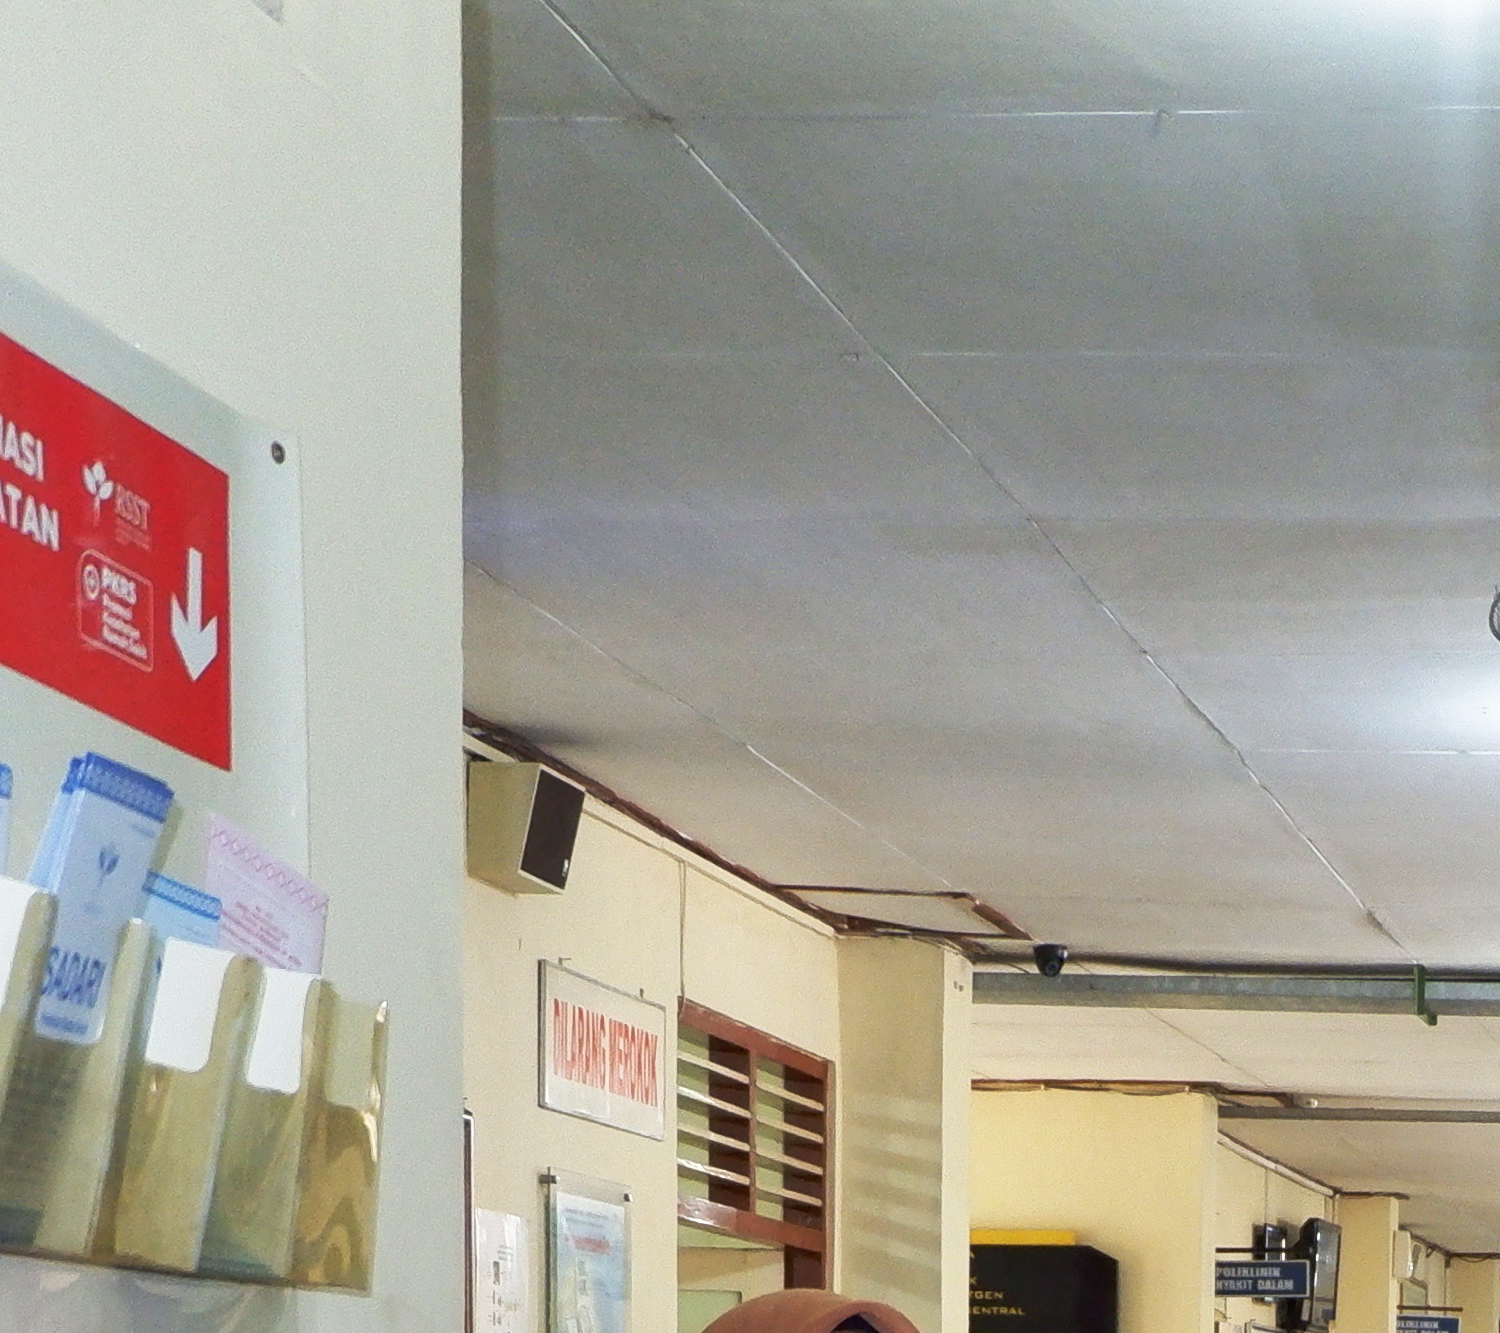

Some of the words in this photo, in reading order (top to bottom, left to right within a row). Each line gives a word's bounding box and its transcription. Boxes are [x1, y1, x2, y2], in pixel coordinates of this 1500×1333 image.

[553, 997, 606, 1090] DILARANG
[608, 1017, 658, 1108] MEROKOK
[970, 1306, 1026, 1316] ENTRAL
